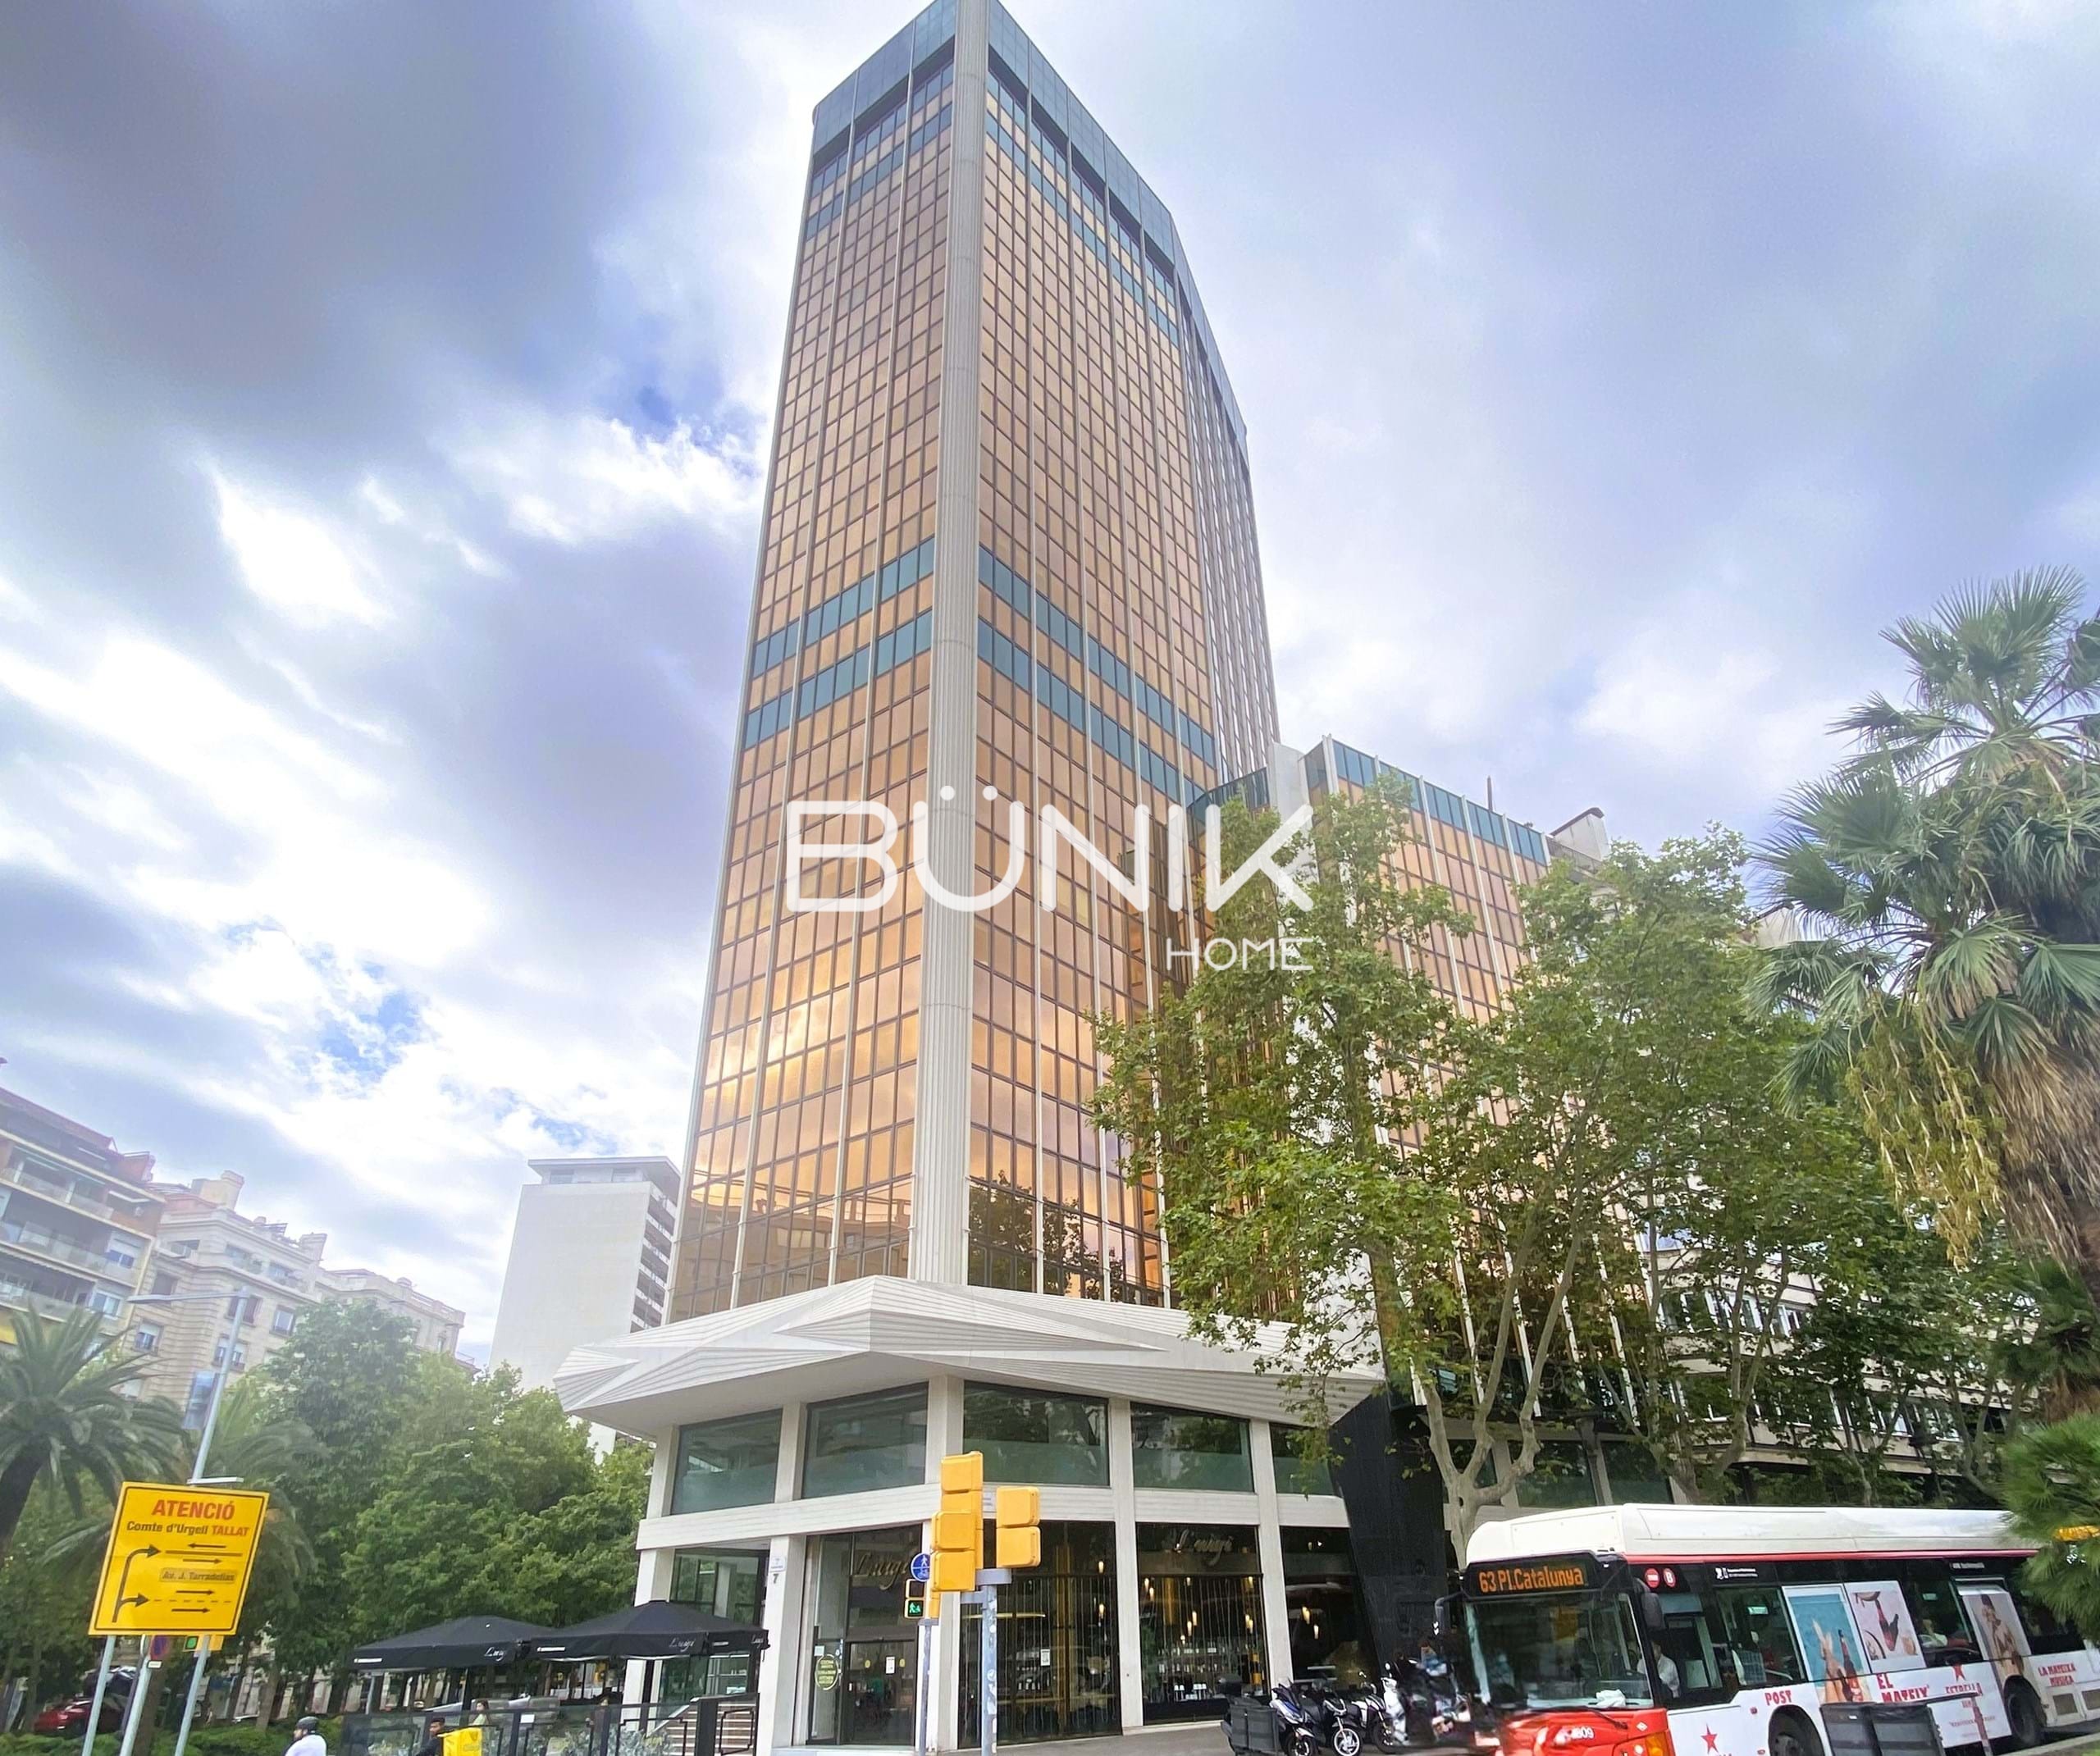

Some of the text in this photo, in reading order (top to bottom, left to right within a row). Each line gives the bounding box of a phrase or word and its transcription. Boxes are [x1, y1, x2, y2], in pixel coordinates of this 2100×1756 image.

[152, 1498, 235, 1520] ATENCIÓ
[126, 1521, 249, 1536] Comte d'Urgell TALLAT
[773, 1573, 779, 1584] 7
[1479, 1571, 1497, 1593] 63
[1876, 1672, 1894, 1690] EL
[1764, 1690, 1792, 1706] POST
